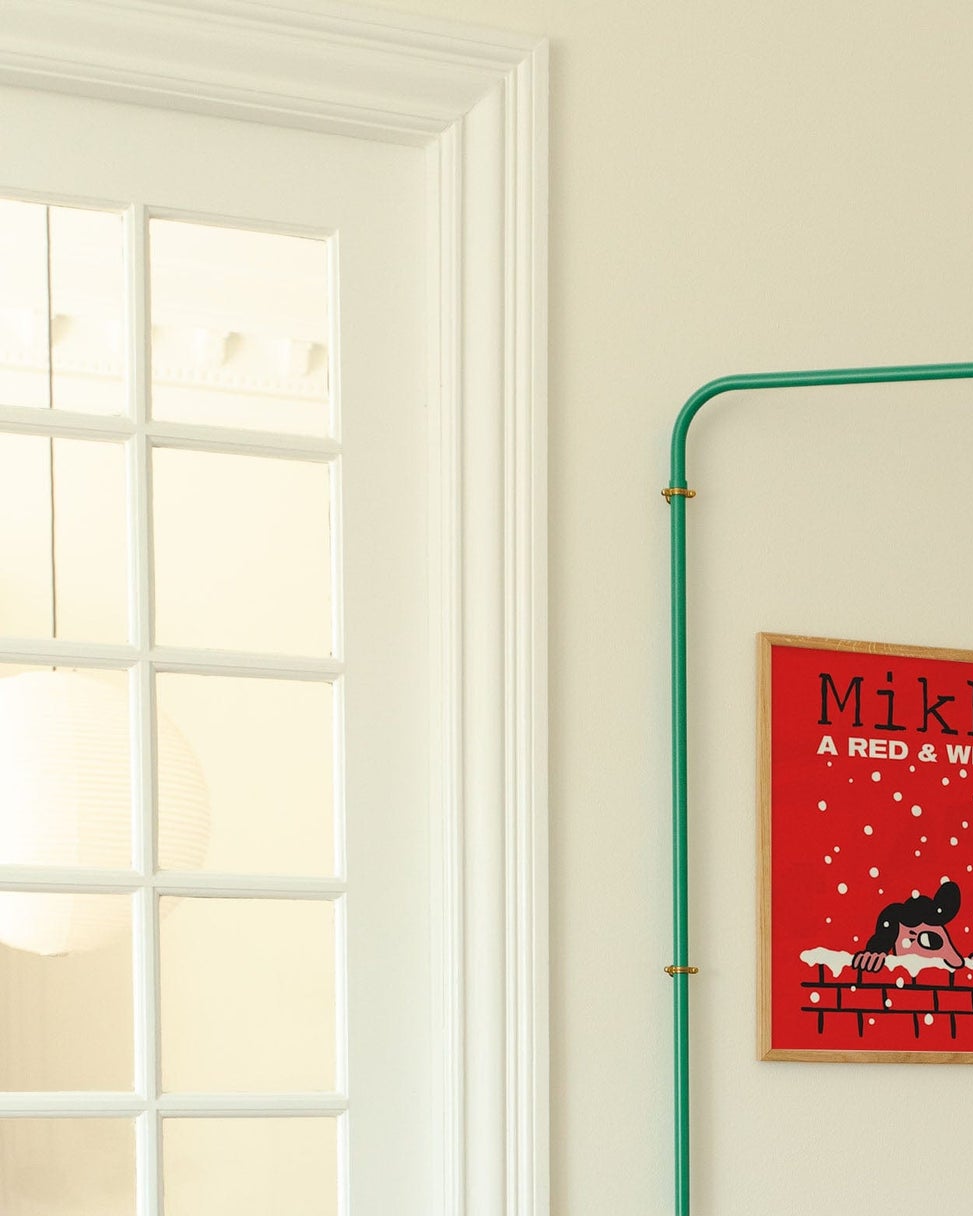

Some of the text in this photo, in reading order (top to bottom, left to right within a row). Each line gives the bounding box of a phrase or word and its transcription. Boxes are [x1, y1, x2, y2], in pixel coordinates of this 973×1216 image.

[816, 735, 838, 756] A
[848, 736, 909, 761] RED
[917, 743, 938, 763] &
